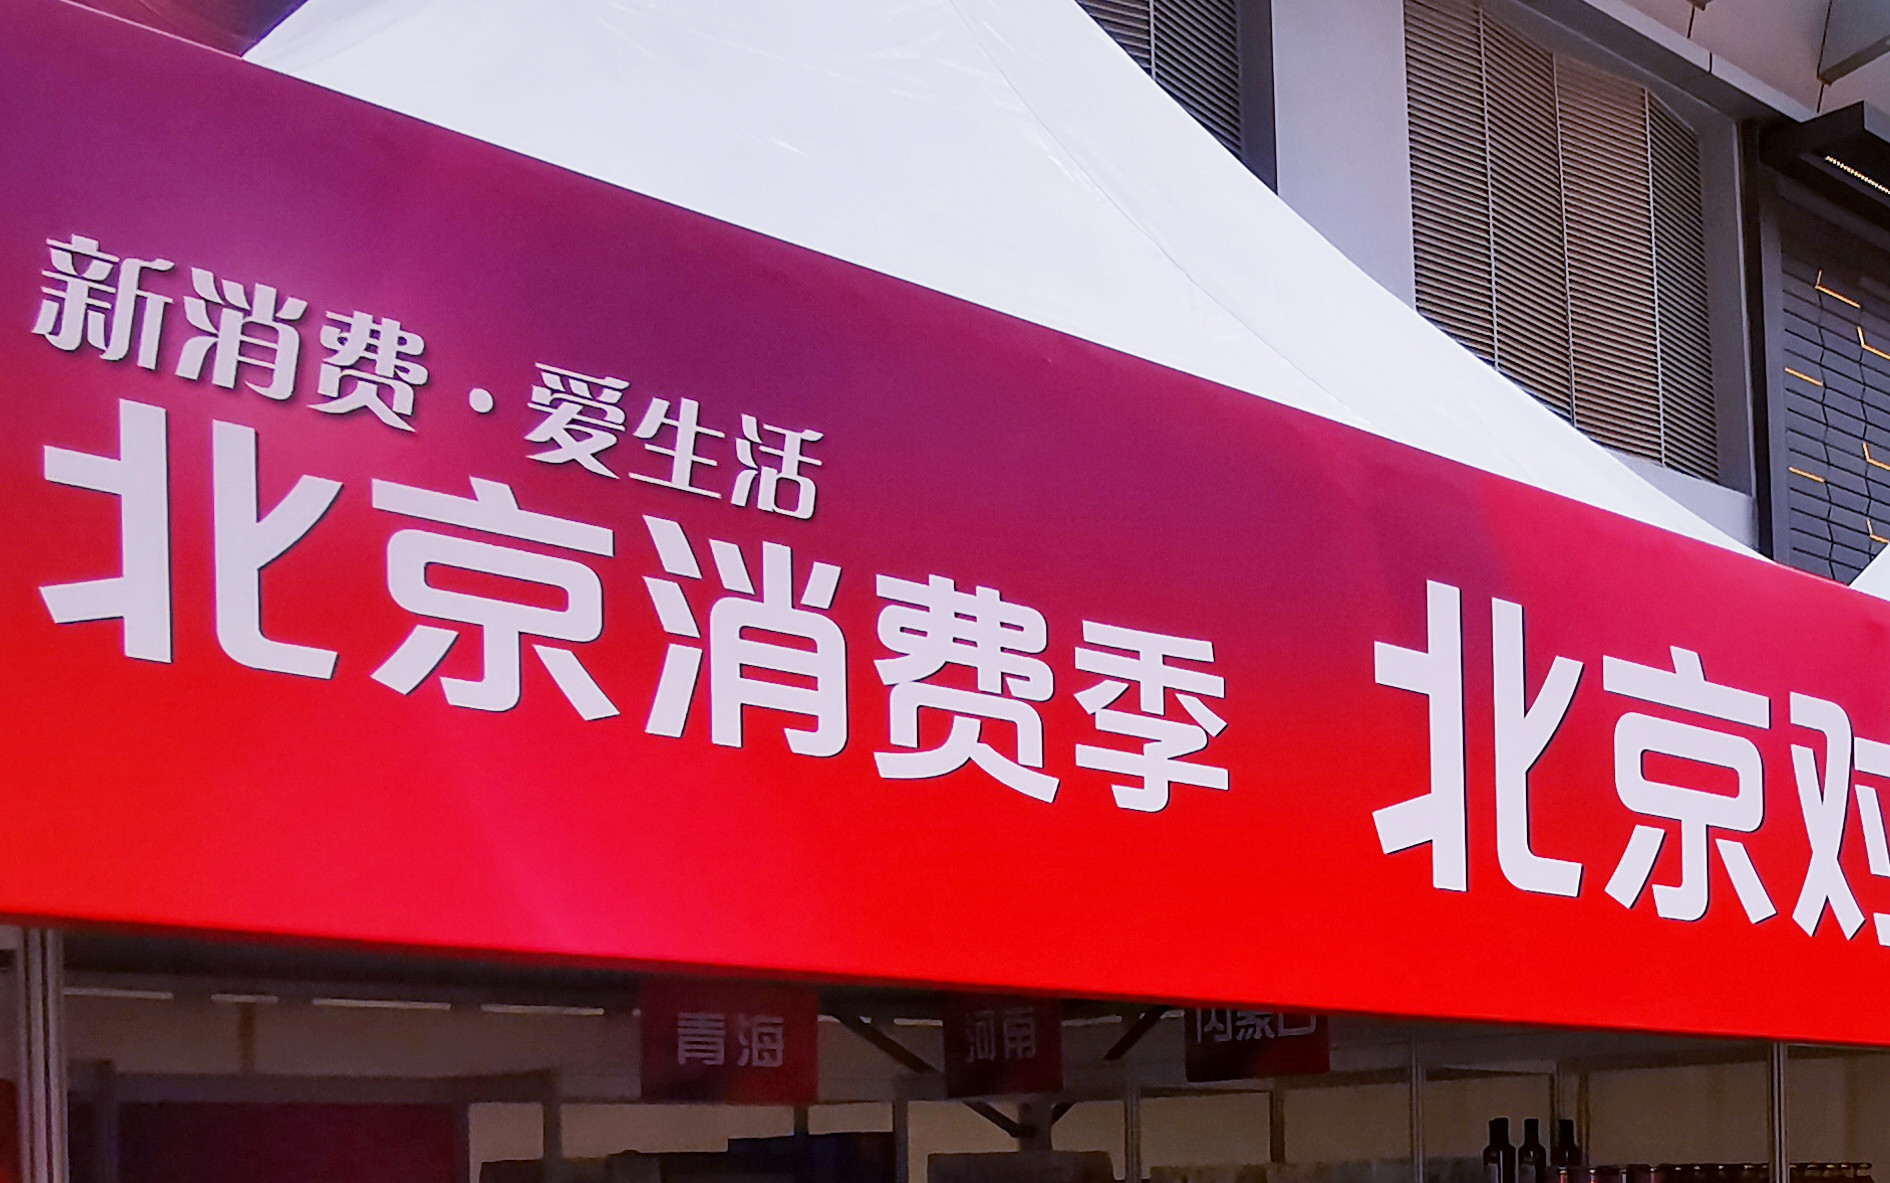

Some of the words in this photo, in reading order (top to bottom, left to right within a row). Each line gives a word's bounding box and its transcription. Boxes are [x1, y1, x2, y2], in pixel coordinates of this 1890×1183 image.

[38, 397, 1229, 813] 北京消费季
[677, 1011, 784, 1068] 青海
[967, 1004, 1038, 1064] 河南
